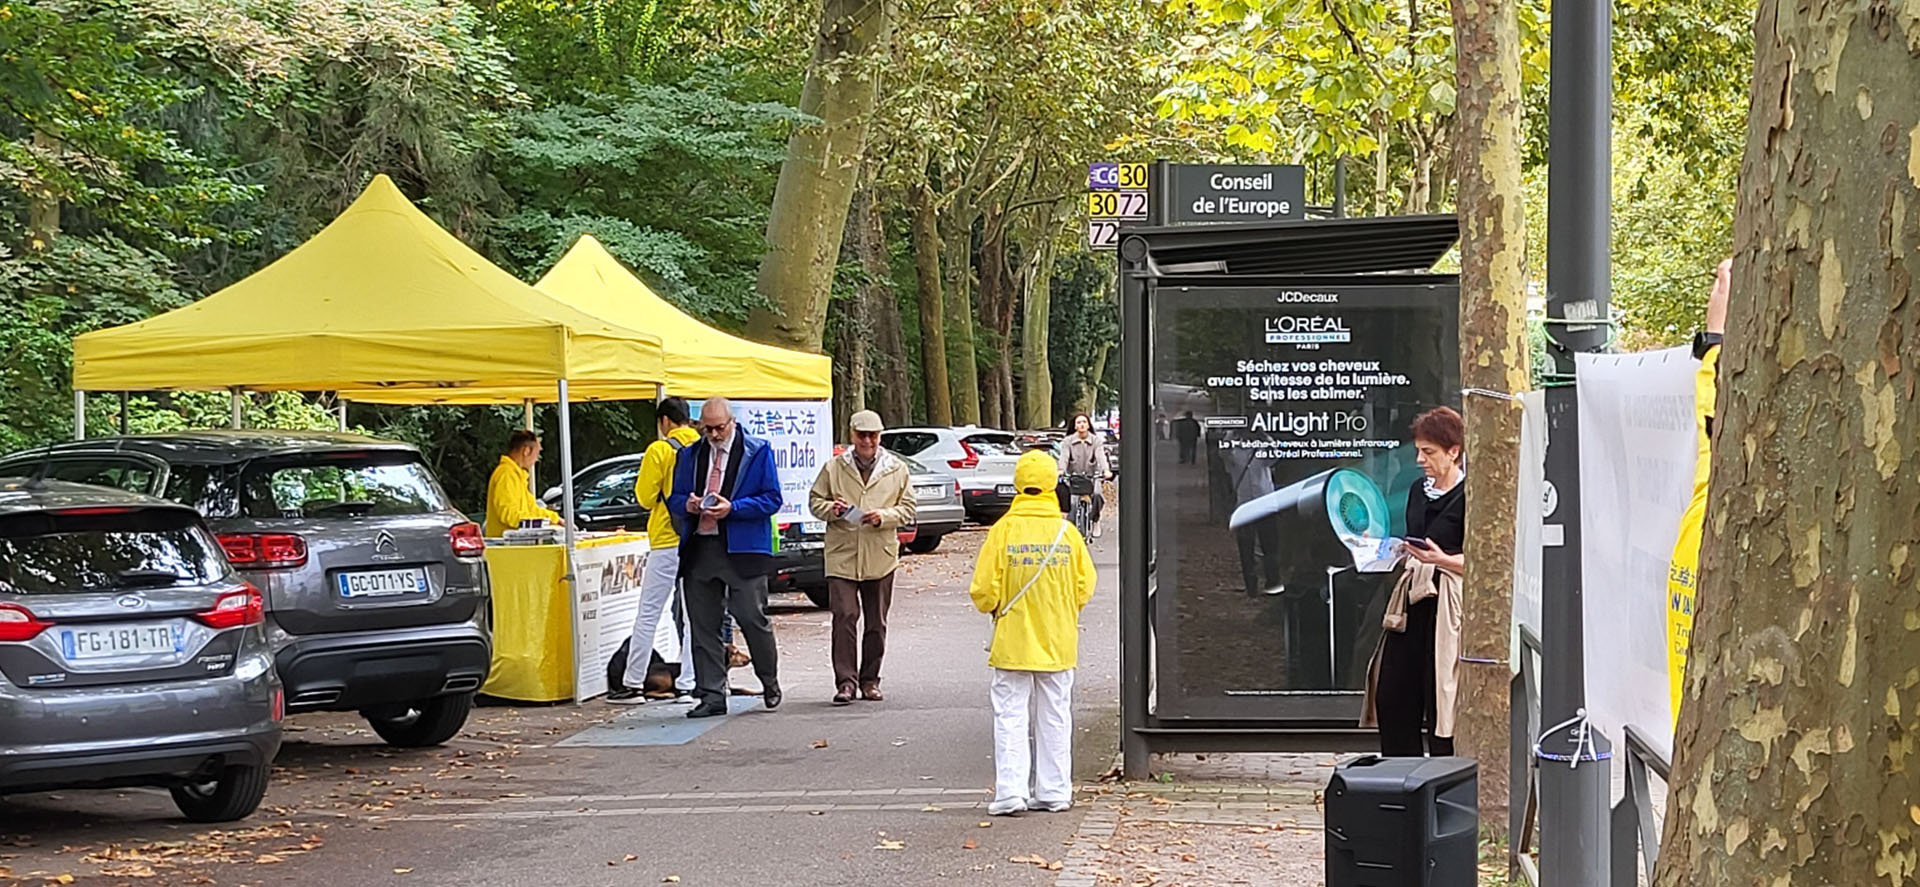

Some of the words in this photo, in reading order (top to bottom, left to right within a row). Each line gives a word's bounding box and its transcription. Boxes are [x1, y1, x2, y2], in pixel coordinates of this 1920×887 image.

[1097, 167, 1118, 184] C6
[1120, 165, 1146, 186] 30
[1210, 173, 1273, 190] Conseil
[1091, 194, 1117, 215] 30
[1120, 194, 1147, 215] 72
[1193, 197, 1215, 214] de
[1219, 197, 1290, 217] l'Europe
[1091, 223, 1117, 244] 72
[1277, 291, 1338, 303] JCDecaux
[1265, 315, 1350, 332] L'ORÉAL
[1237, 360, 1289, 372] Séchez
[1291, 363, 1316, 372] vos
[1319, 360, 1380, 372] cheveux
[1207, 376, 1243, 386] avec
[1246, 374, 1261, 386] la
[1262, 374, 1312, 386] vitesse
[1315, 374, 1333, 386] de
[1336, 374, 1350, 385] la
[1353, 373, 1410, 385] lumière.
[1250, 388, 1285, 400] Sans
[1287, 388, 1308, 399] les
[748, 409, 816, 436] 法輪大法
[1251, 412, 1329, 436] AirLight
[1335, 412, 1367, 431] Pro
[1319, 440, 1351, 448] lumière
[1353, 440, 1400, 450] infrarouge
[790, 441, 815, 468] Dafa
[1255, 450, 1267, 458] de
